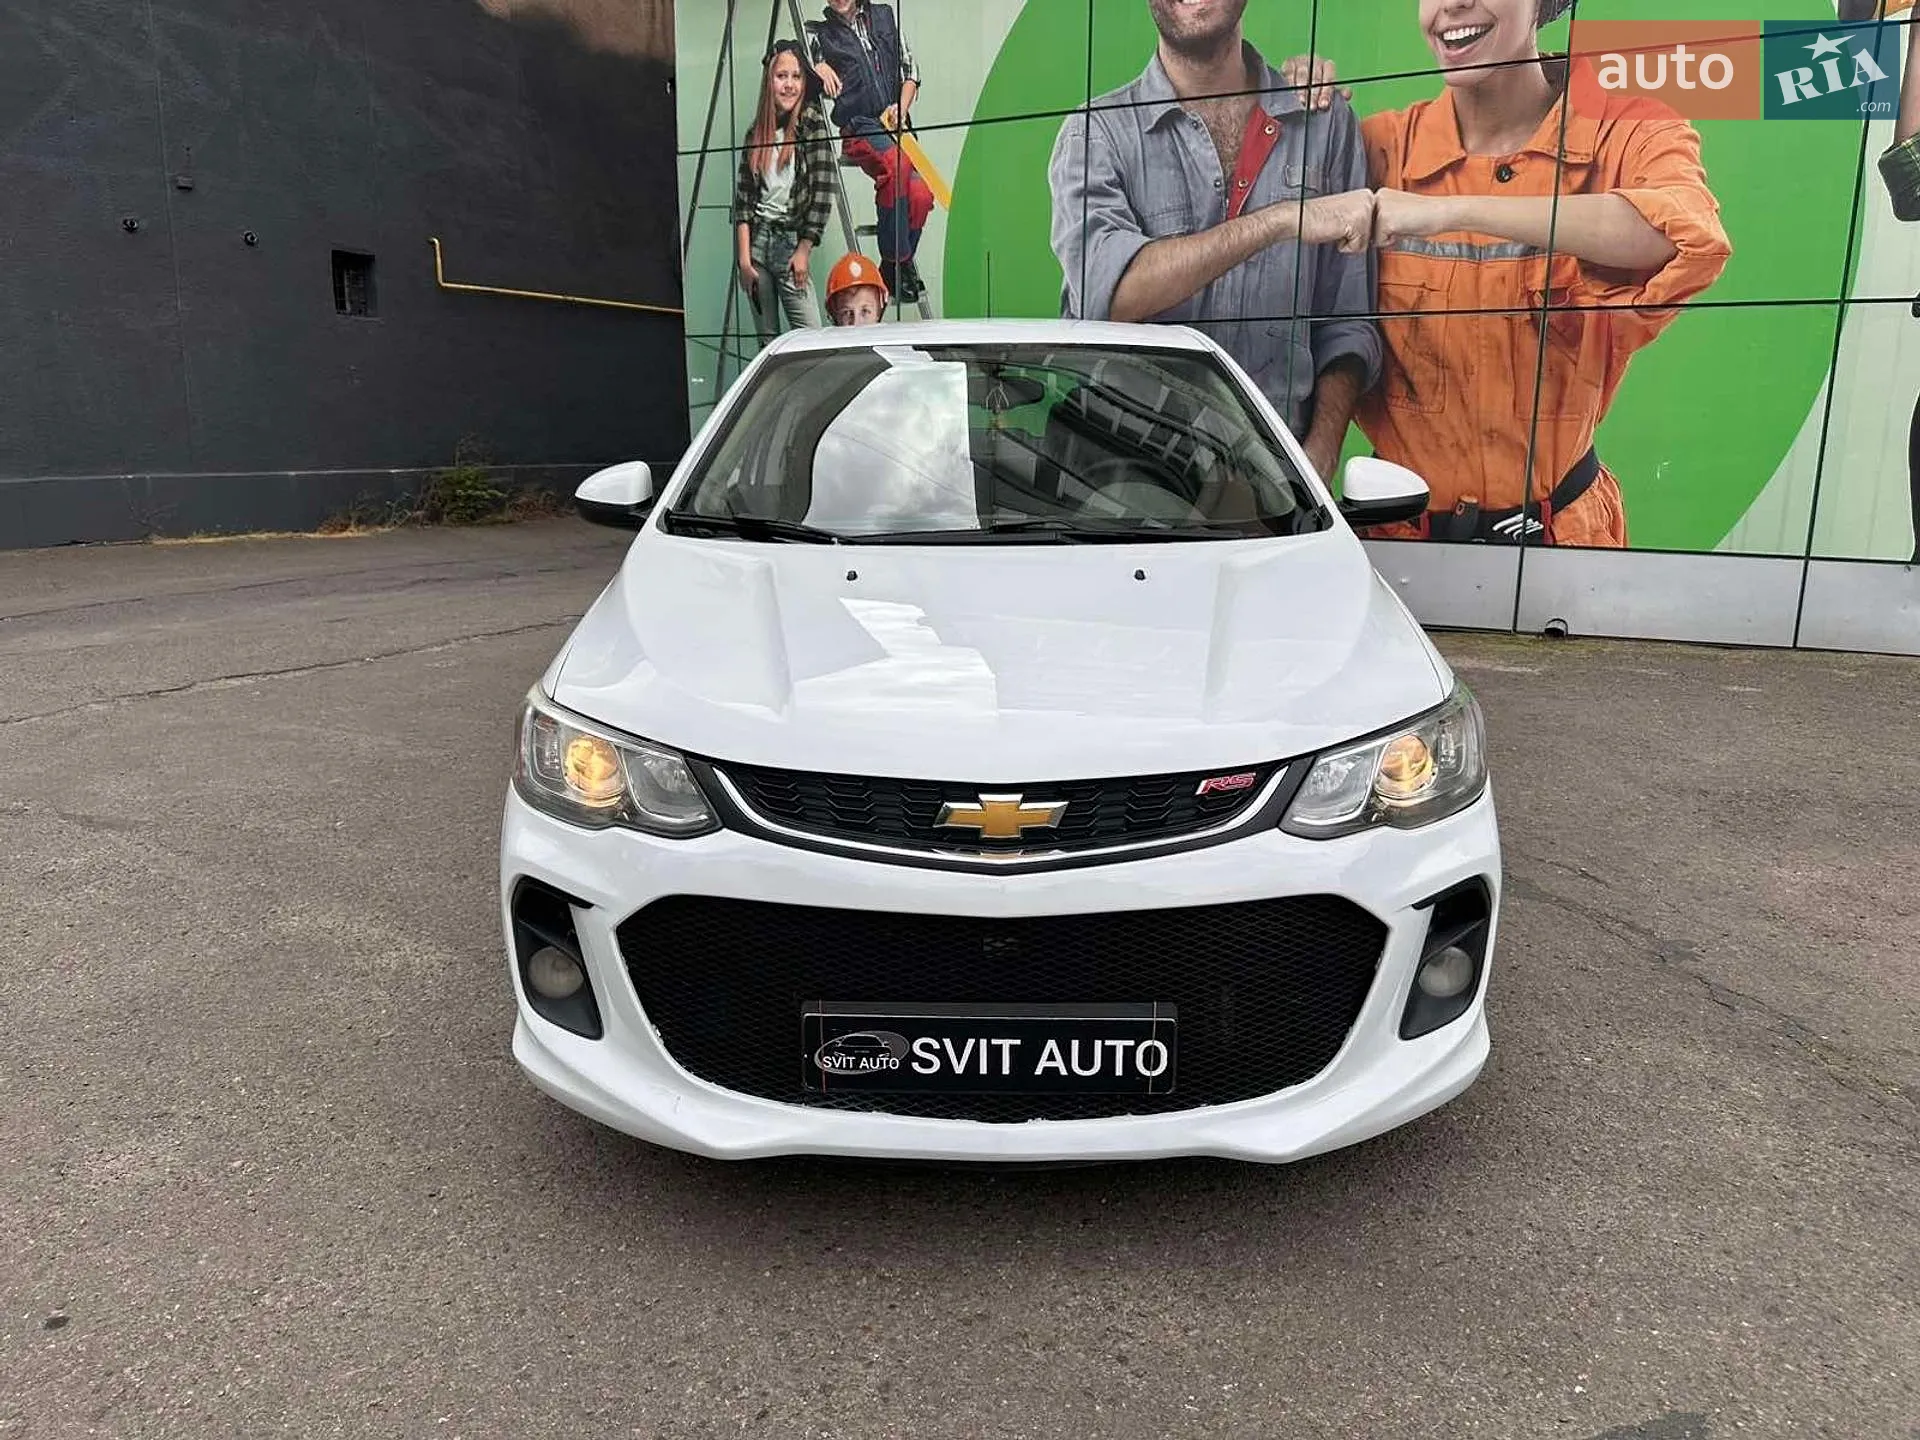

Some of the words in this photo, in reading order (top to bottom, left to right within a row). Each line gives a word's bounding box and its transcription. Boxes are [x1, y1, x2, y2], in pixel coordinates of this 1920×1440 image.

[1196, 772, 1256, 795] RS
[822, 1056, 856, 1069] SVIT
[859, 1057, 900, 1070] AUTO
[911, 1037, 1021, 1075] SVIT
[1034, 1039, 1168, 1077] AUTO
